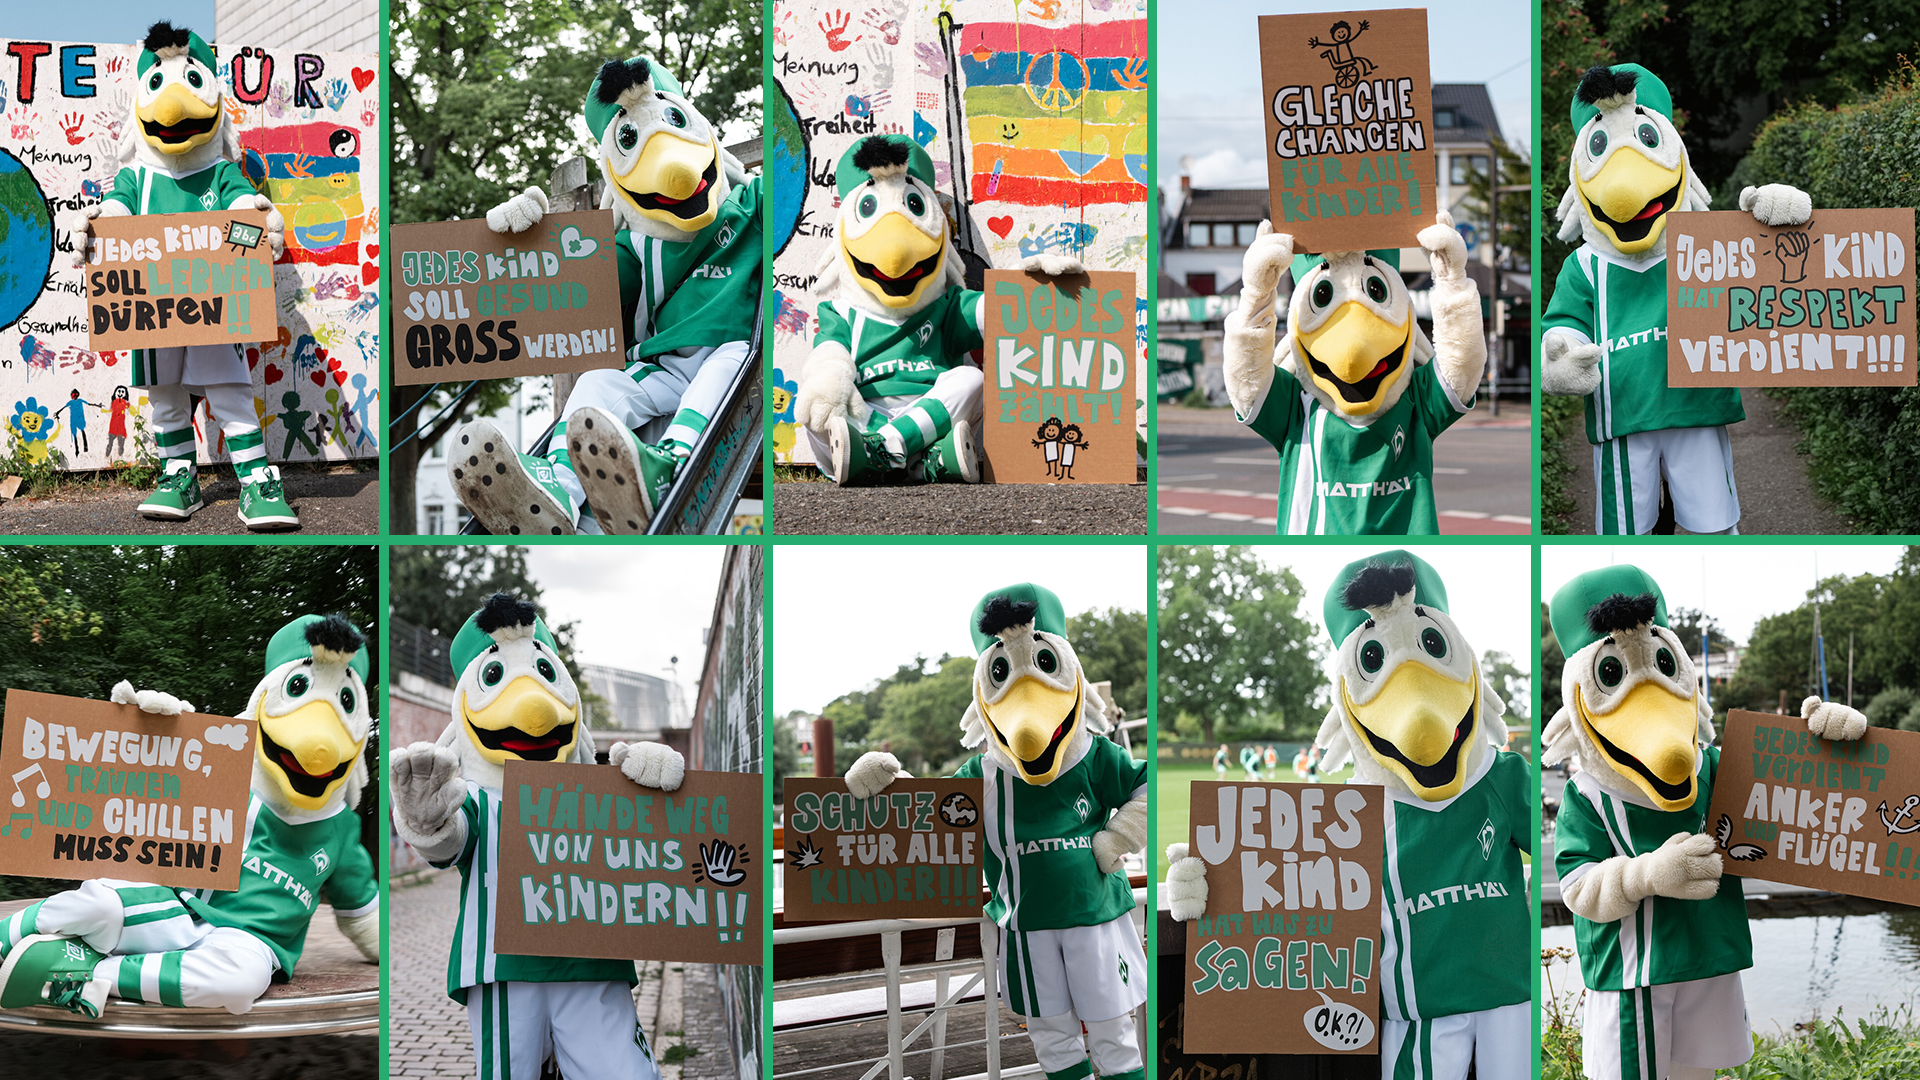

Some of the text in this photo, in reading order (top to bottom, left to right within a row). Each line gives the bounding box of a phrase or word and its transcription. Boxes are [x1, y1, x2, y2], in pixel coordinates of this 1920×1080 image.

[803, 110, 877, 141] Freiheit
[1275, 120, 1426, 158] CHANCEN
[19, 145, 92, 171] Meinung
[1281, 156, 1348, 189] FÜR
[232, 226, 256, 244] abc
[91, 269, 146, 297] SOLL
[402, 250, 481, 287] JEDES
[403, 281, 589, 321] SOLL GESUND
[1677, 285, 1905, 332] HAT RESPEKT
[17, 315, 89, 336] Gesundhe
[405, 320, 617, 369] GROSS WERDEN!
[996, 333, 1127, 393] KIND
[1316, 476, 1411, 498] MATTHÄI
[22, 716, 212, 778] BEWEGUNG,
[1753, 725, 1890, 765] JEDES KIND
[38, 798, 233, 844] UND CHILLEN
[518, 782, 729, 835] HÄNDE WEG
[791, 791, 936, 834] SCHUTZ
[1196, 786, 1367, 865] JEDES
[1743, 782, 1868, 835] ANKER
[836, 831, 977, 866] FÜR ALLE
[1744, 820, 1777, 843] UND
[53, 833, 222, 872] MUSS SEIN!
[526, 832, 686, 872] VON UNS
[241, 853, 313, 911] ATTHÄI
[810, 865, 977, 907] KINDER!!!
[1393, 882, 1509, 920] MATTHÄI
[1196, 913, 1333, 937] HAT WAS ZU
